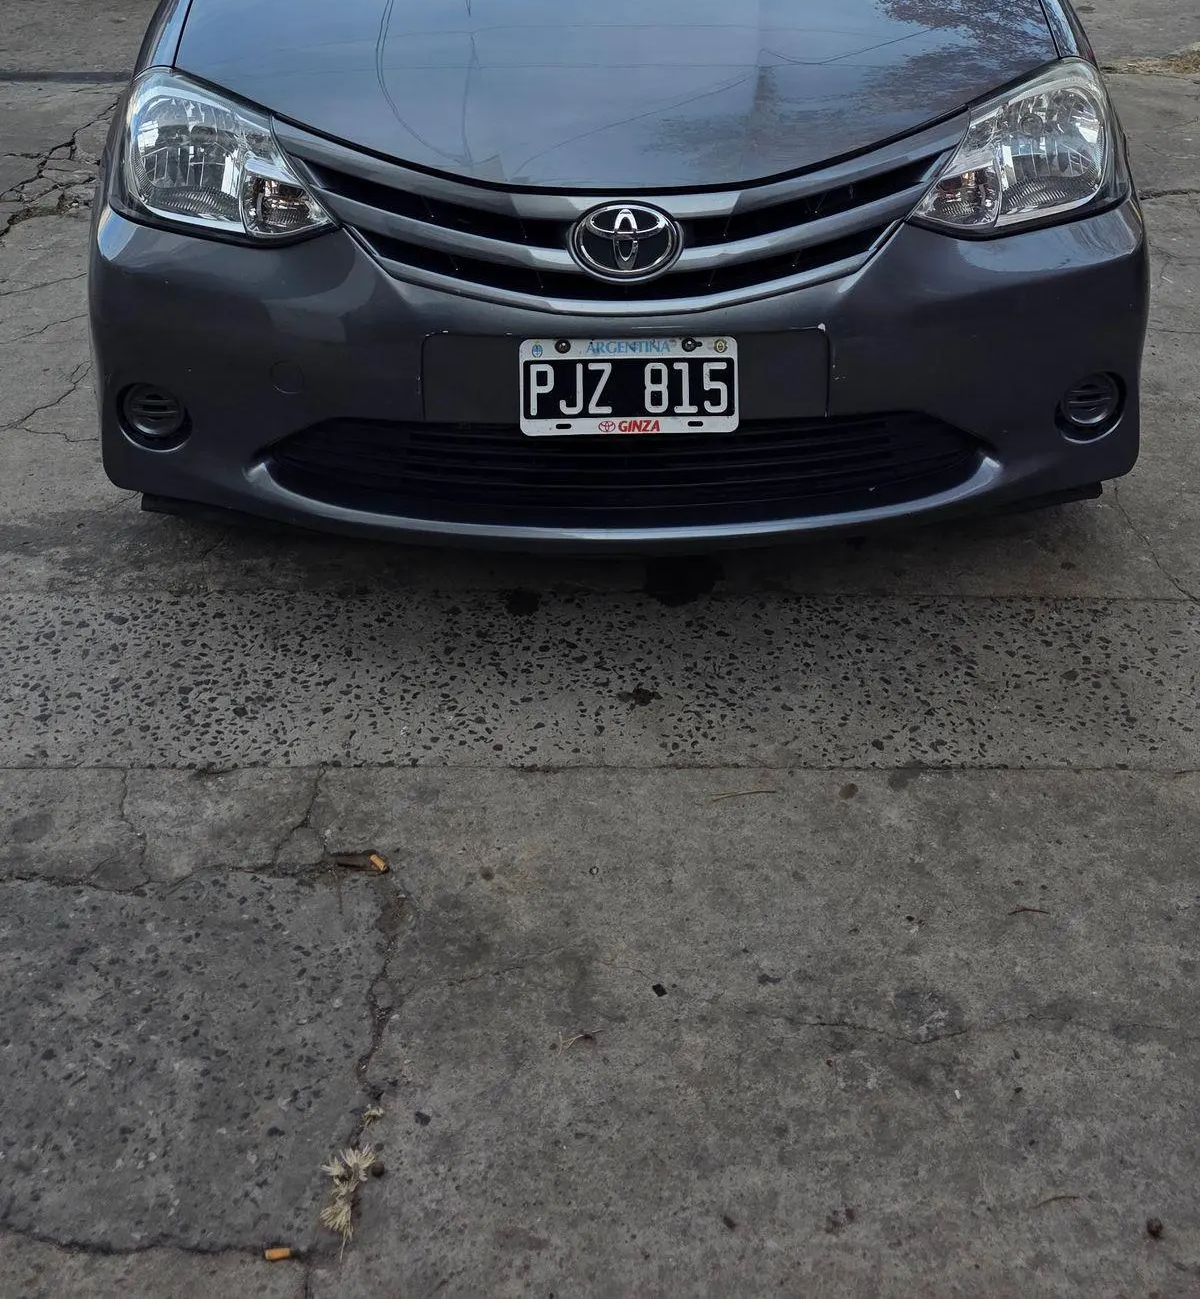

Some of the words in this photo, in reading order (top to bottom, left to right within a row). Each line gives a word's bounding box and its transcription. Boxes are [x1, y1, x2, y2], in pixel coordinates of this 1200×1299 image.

[586, 339, 671, 354] ARGENTINA
[529, 362, 613, 416] PJZ
[644, 361, 728, 413] 815
[618, 419, 661, 433] GINZA
